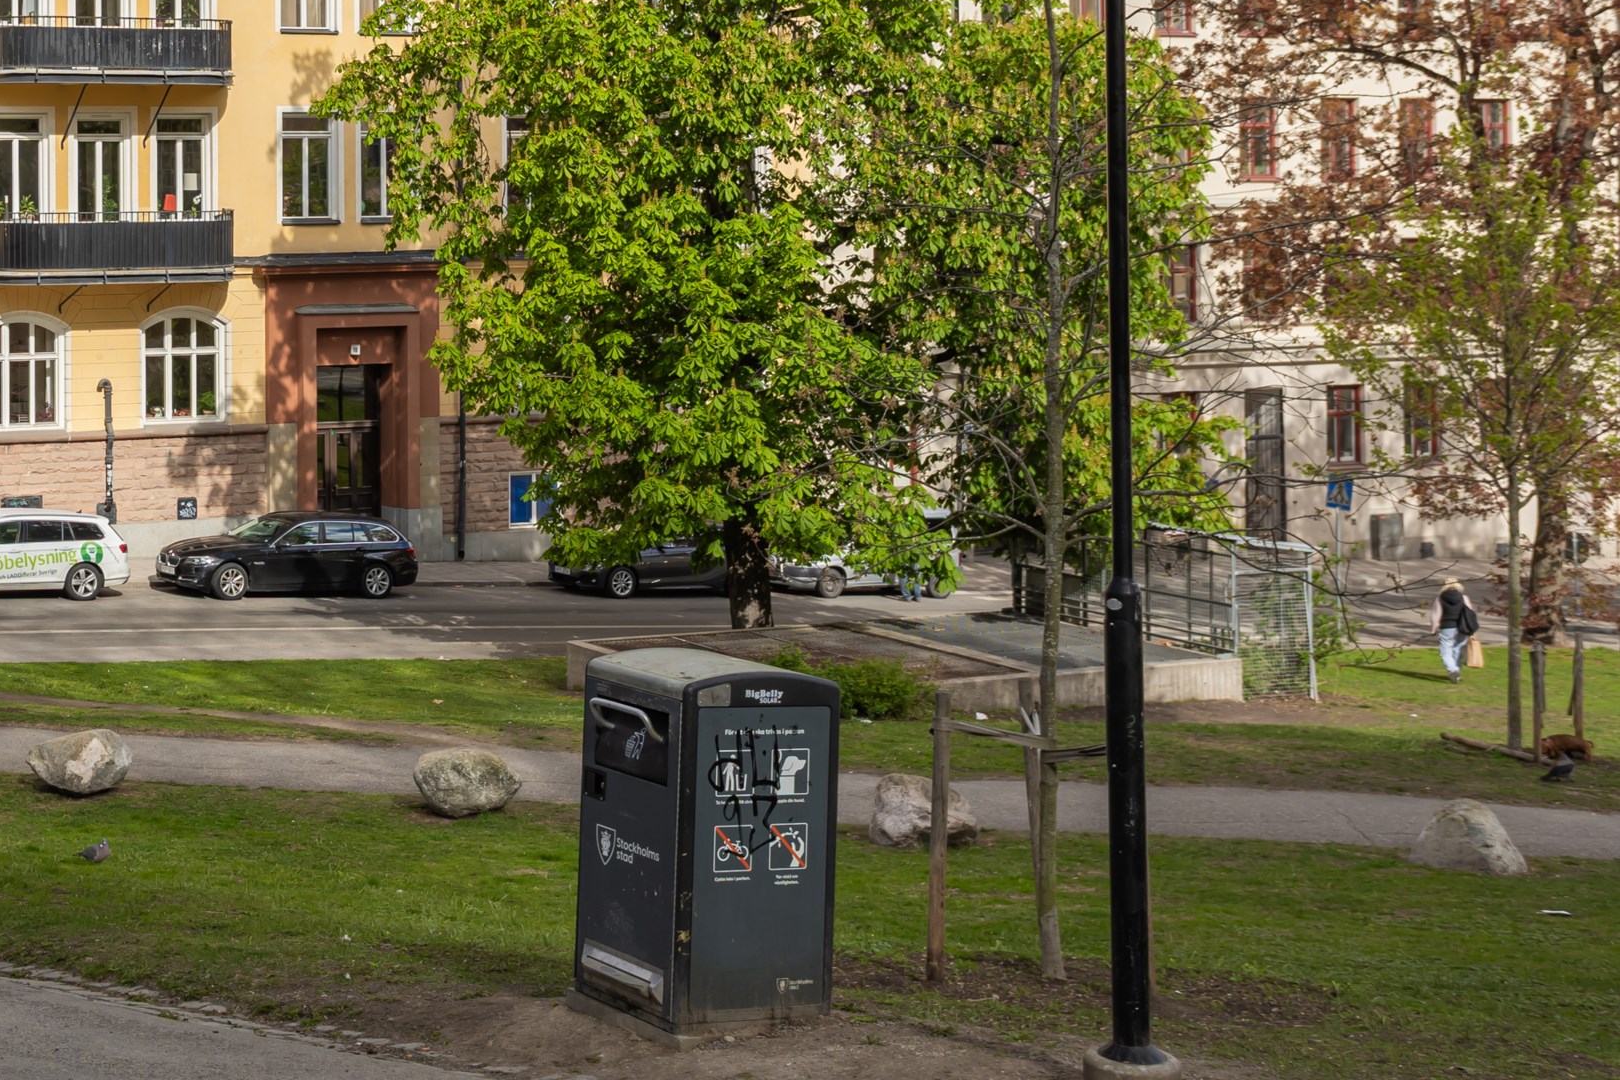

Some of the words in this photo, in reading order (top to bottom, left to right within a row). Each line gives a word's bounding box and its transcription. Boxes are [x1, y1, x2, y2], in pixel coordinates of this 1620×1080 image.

[745, 689, 783, 699] BigBelly
[616, 837, 660, 862] Stockholms
[616, 850, 634, 864] stad
